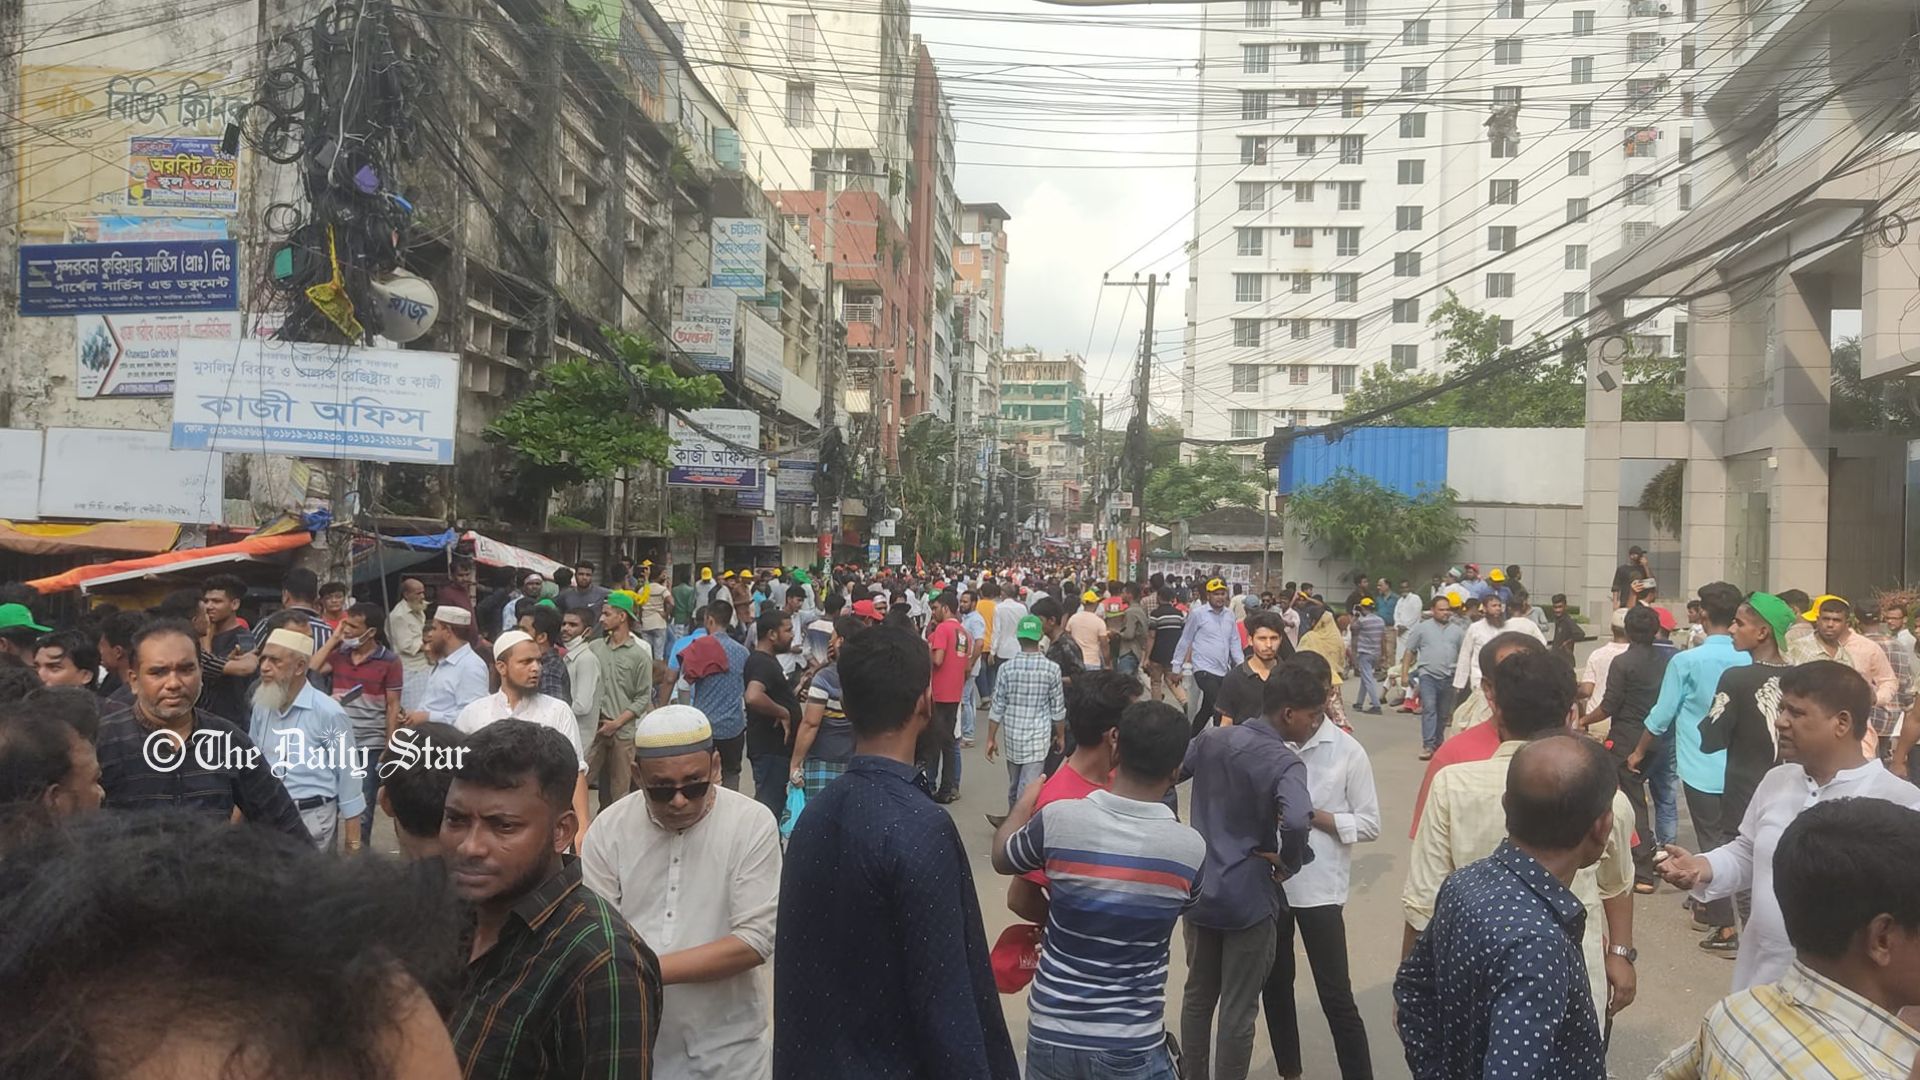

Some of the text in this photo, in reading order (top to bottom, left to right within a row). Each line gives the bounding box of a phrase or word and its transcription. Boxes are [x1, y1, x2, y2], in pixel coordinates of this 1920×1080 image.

[148, 153, 202, 177] অরবিট
[158, 176, 234, 190] স্কুল কলেজ
[53, 257, 98, 281] সুন্দরবন
[101, 251, 143, 280] কুরিয়ার
[145, 249, 178, 274] সার্ভিস
[210, 248, 231, 271] লিঃ
[102, 278, 143, 292] সার্ভিস
[148, 279, 174, 290] এন্ড
[176, 275, 231, 291] ডকুমেন্ট
[193, 360, 235, 376] মুসলিম
[241, 360, 275, 378] বিবাহ
[281, 367, 291, 378] ও
[396, 376, 406, 387] ও
[411, 374, 442, 390] কাজী
[195, 388, 299, 424] কাজী
[310, 396, 432, 433] অফিস
[674, 444, 750, 466] কাজী অফিস
